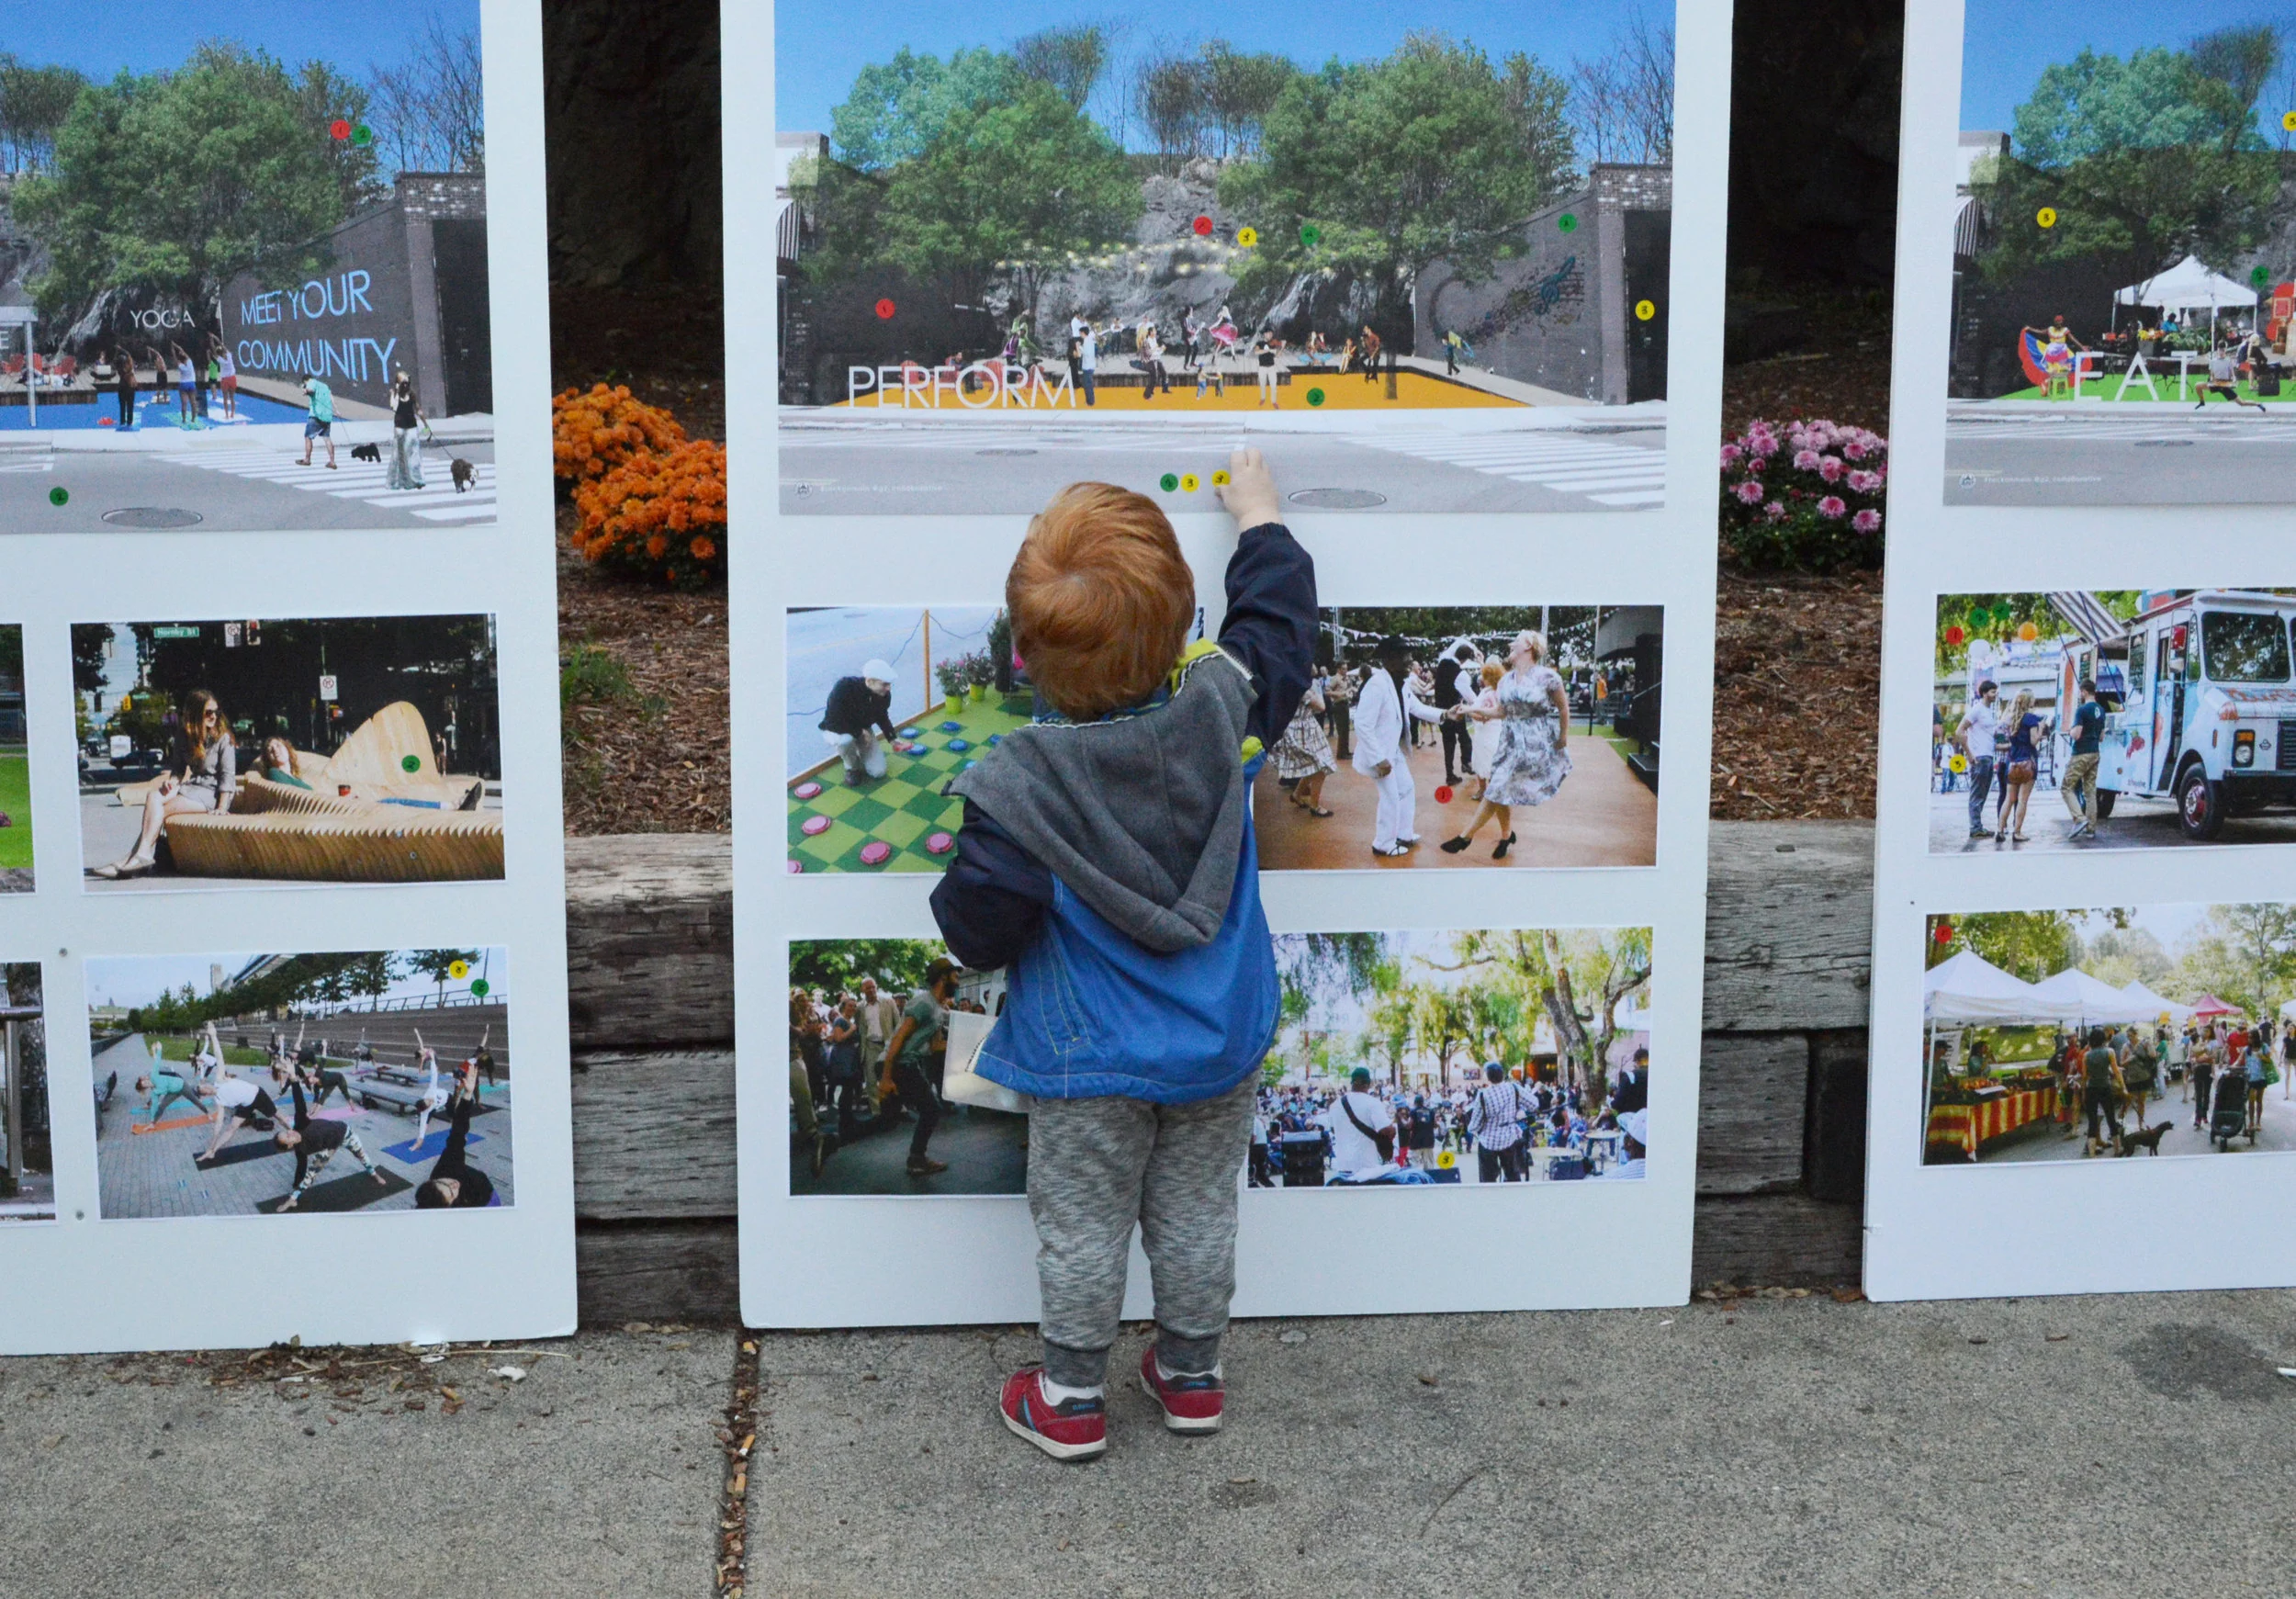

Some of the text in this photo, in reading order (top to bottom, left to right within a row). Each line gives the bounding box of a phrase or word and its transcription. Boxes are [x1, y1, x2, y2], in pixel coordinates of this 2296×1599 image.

[130, 310, 196, 329] YOGA
[242, 269, 372, 325] MEET YOUR
[238, 337, 397, 384] COMMUNITY
[2074, 350, 2198, 401] EAT
[849, 365, 1076, 408] PERFORM
